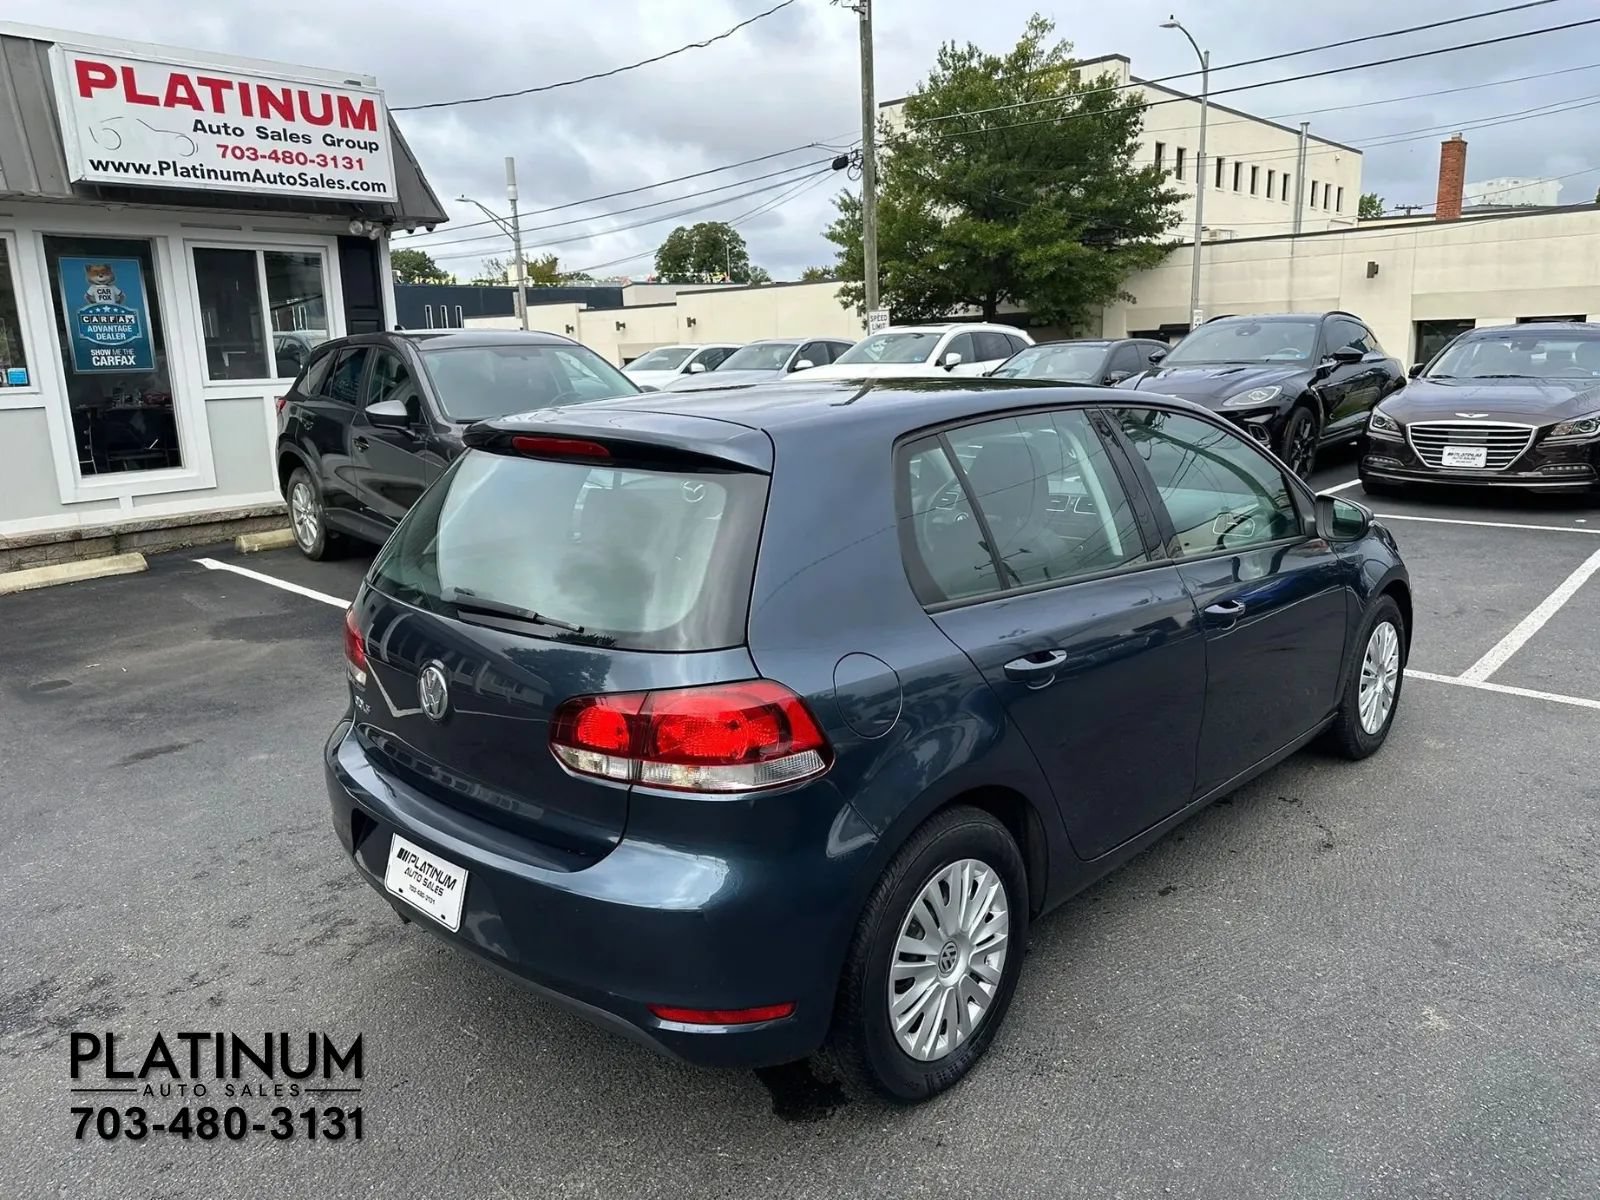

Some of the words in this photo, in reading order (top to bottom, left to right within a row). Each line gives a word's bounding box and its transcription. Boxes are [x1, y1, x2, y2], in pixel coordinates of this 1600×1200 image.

[75, 60, 377, 132] PLATINUM
[193, 119, 245, 138] Auto
[255, 126, 312, 144] Sales
[322, 134, 380, 153] Group
[216, 144, 365, 171] 703-480-3131
[88, 159, 387, 193] www.PlatinumAutoSales.com
[82, 315, 135, 324] CARFAX
[870, 314, 887, 322] SPEED
[92, 356, 136, 366] CARFAX
[404, 867, 423, 883] AUTO
[422, 877, 445, 896] SALES
[408, 853, 457, 891] PLATINUM
